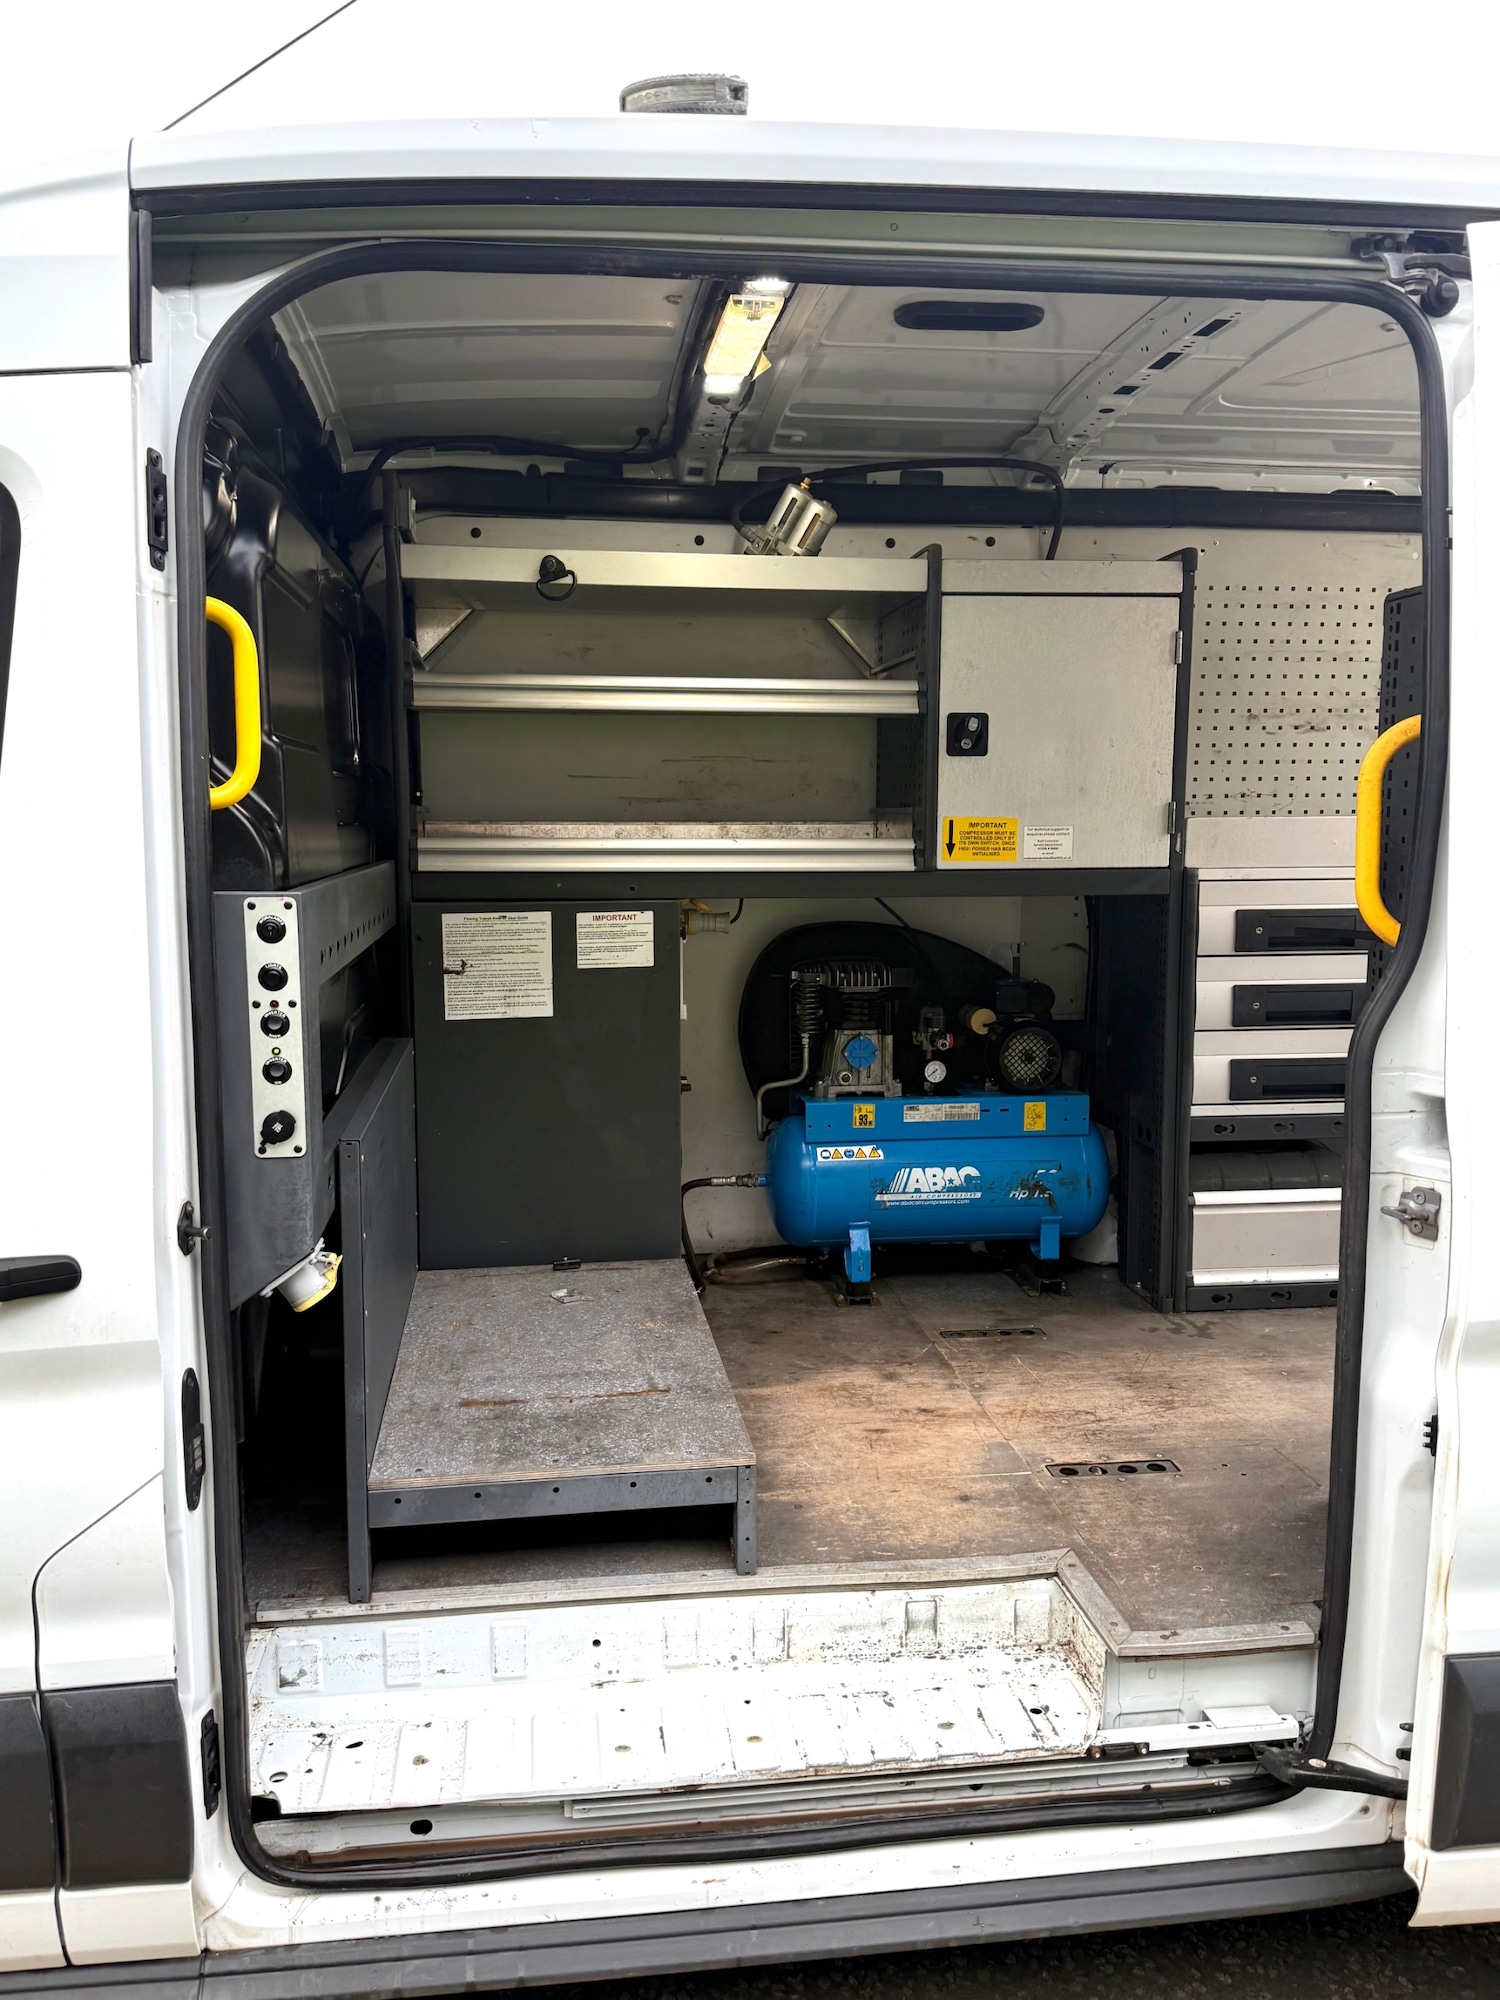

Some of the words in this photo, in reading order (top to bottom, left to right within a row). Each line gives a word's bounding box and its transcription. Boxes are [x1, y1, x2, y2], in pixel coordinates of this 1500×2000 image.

[592, 914, 637, 922] IMPORTANT
[858, 1113, 869, 1126] 93
[905, 1166, 981, 1193] ABAC
